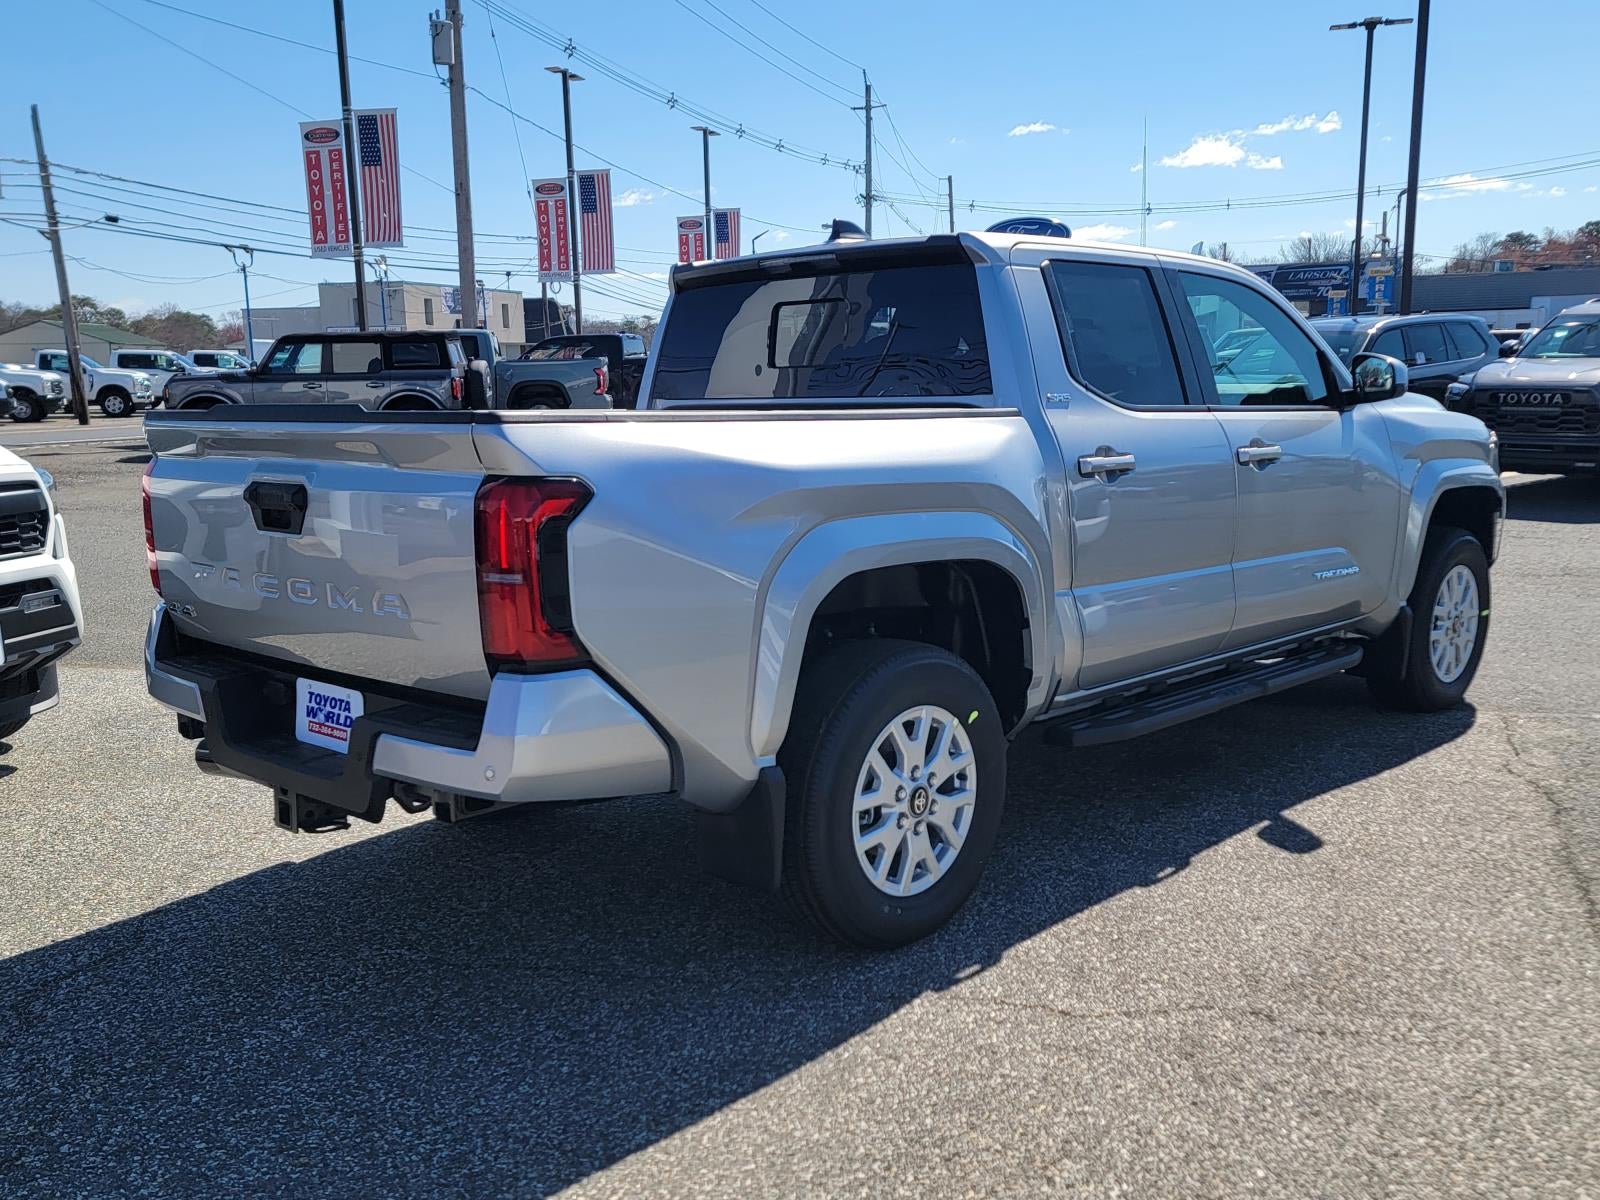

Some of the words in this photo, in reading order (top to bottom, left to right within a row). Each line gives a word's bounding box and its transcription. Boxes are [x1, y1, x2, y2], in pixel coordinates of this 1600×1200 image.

[309, 154, 325, 241] TOYOTA
[331, 151, 347, 241] CERTIFIED
[539, 202, 550, 269] TOYOTA
[556, 200, 567, 269] CERTIFIED
[1498, 393, 1564, 404] TOYOTA
[190, 560, 409, 619] TACOMA
[1312, 566, 1360, 580] TACOMA
[306, 705, 353, 728] WORLD
[308, 691, 351, 713] TOYOTA
